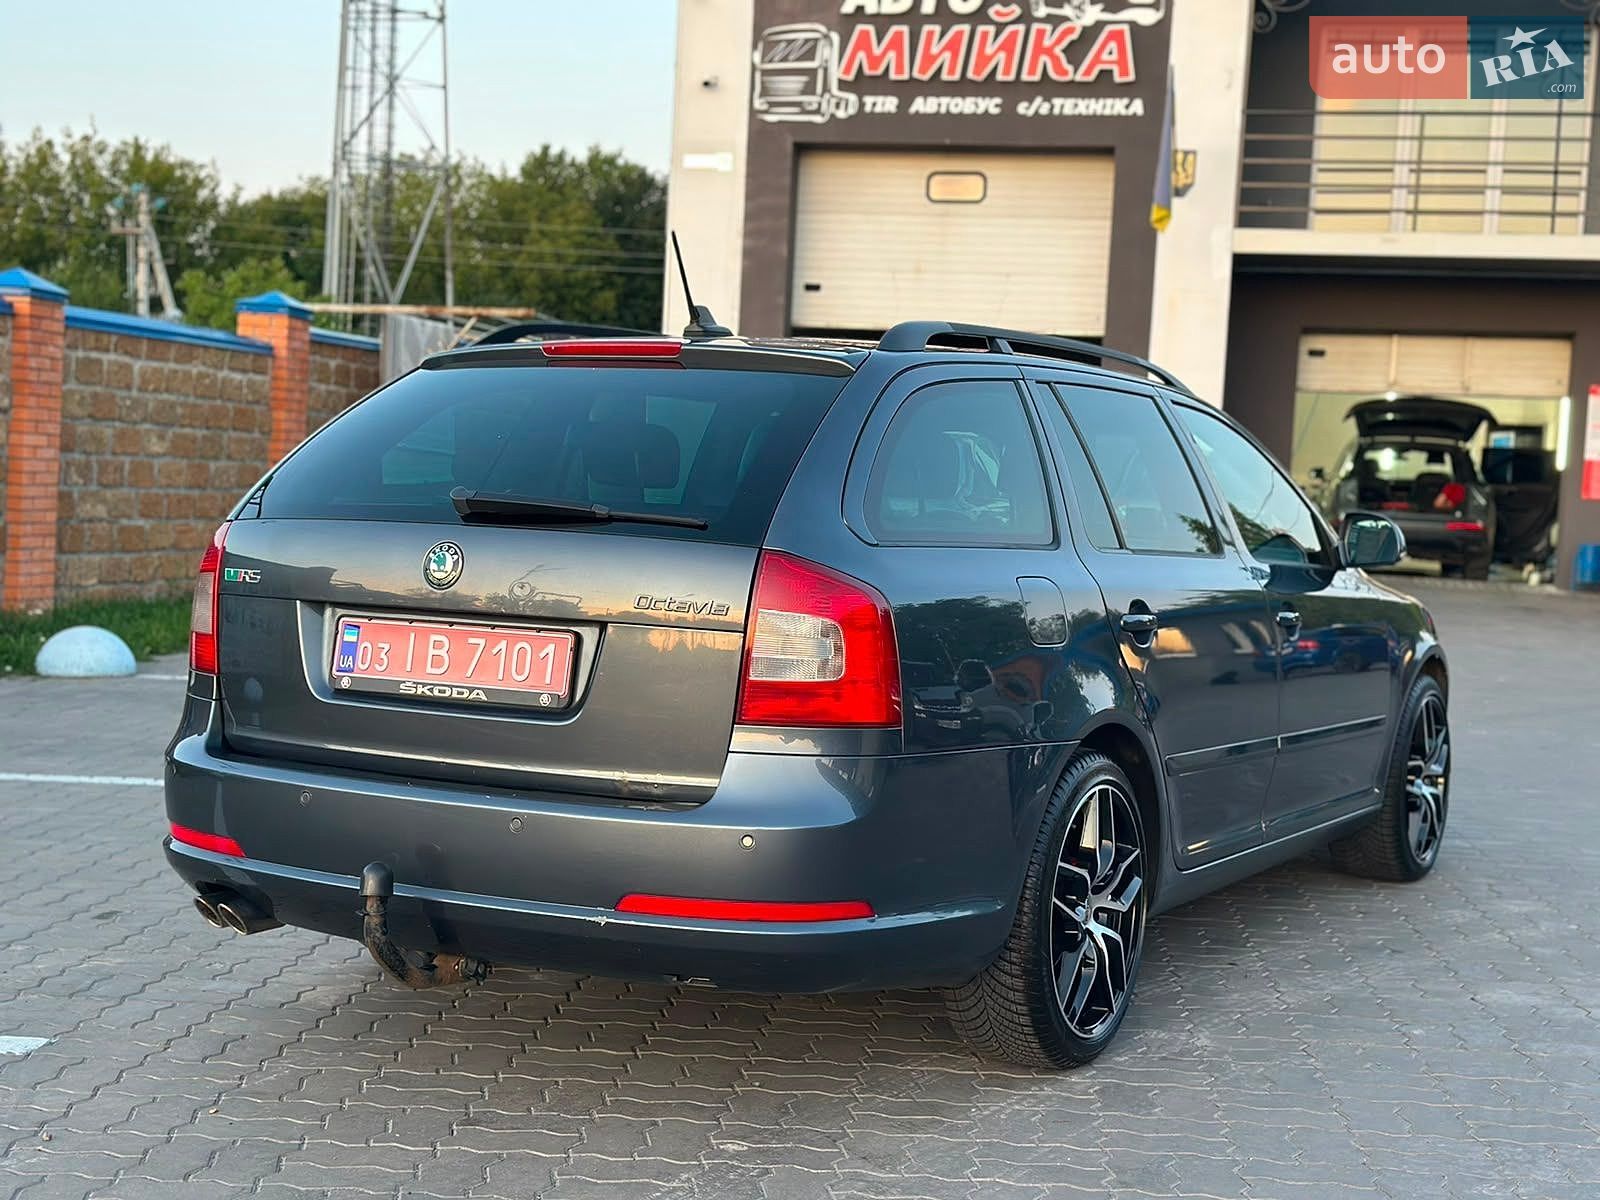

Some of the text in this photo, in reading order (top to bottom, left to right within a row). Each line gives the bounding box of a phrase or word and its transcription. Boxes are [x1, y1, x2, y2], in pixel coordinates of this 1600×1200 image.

[838, 3, 1137, 82] МИЙКА
[909, 96, 1003, 115] АВТОБУС
[633, 594, 730, 616] Octavia
[339, 654, 354, 669] UA
[358, 641, 392, 672] 03
[465, 637, 557, 685] 7101
[399, 681, 488, 701] ŠKODA
